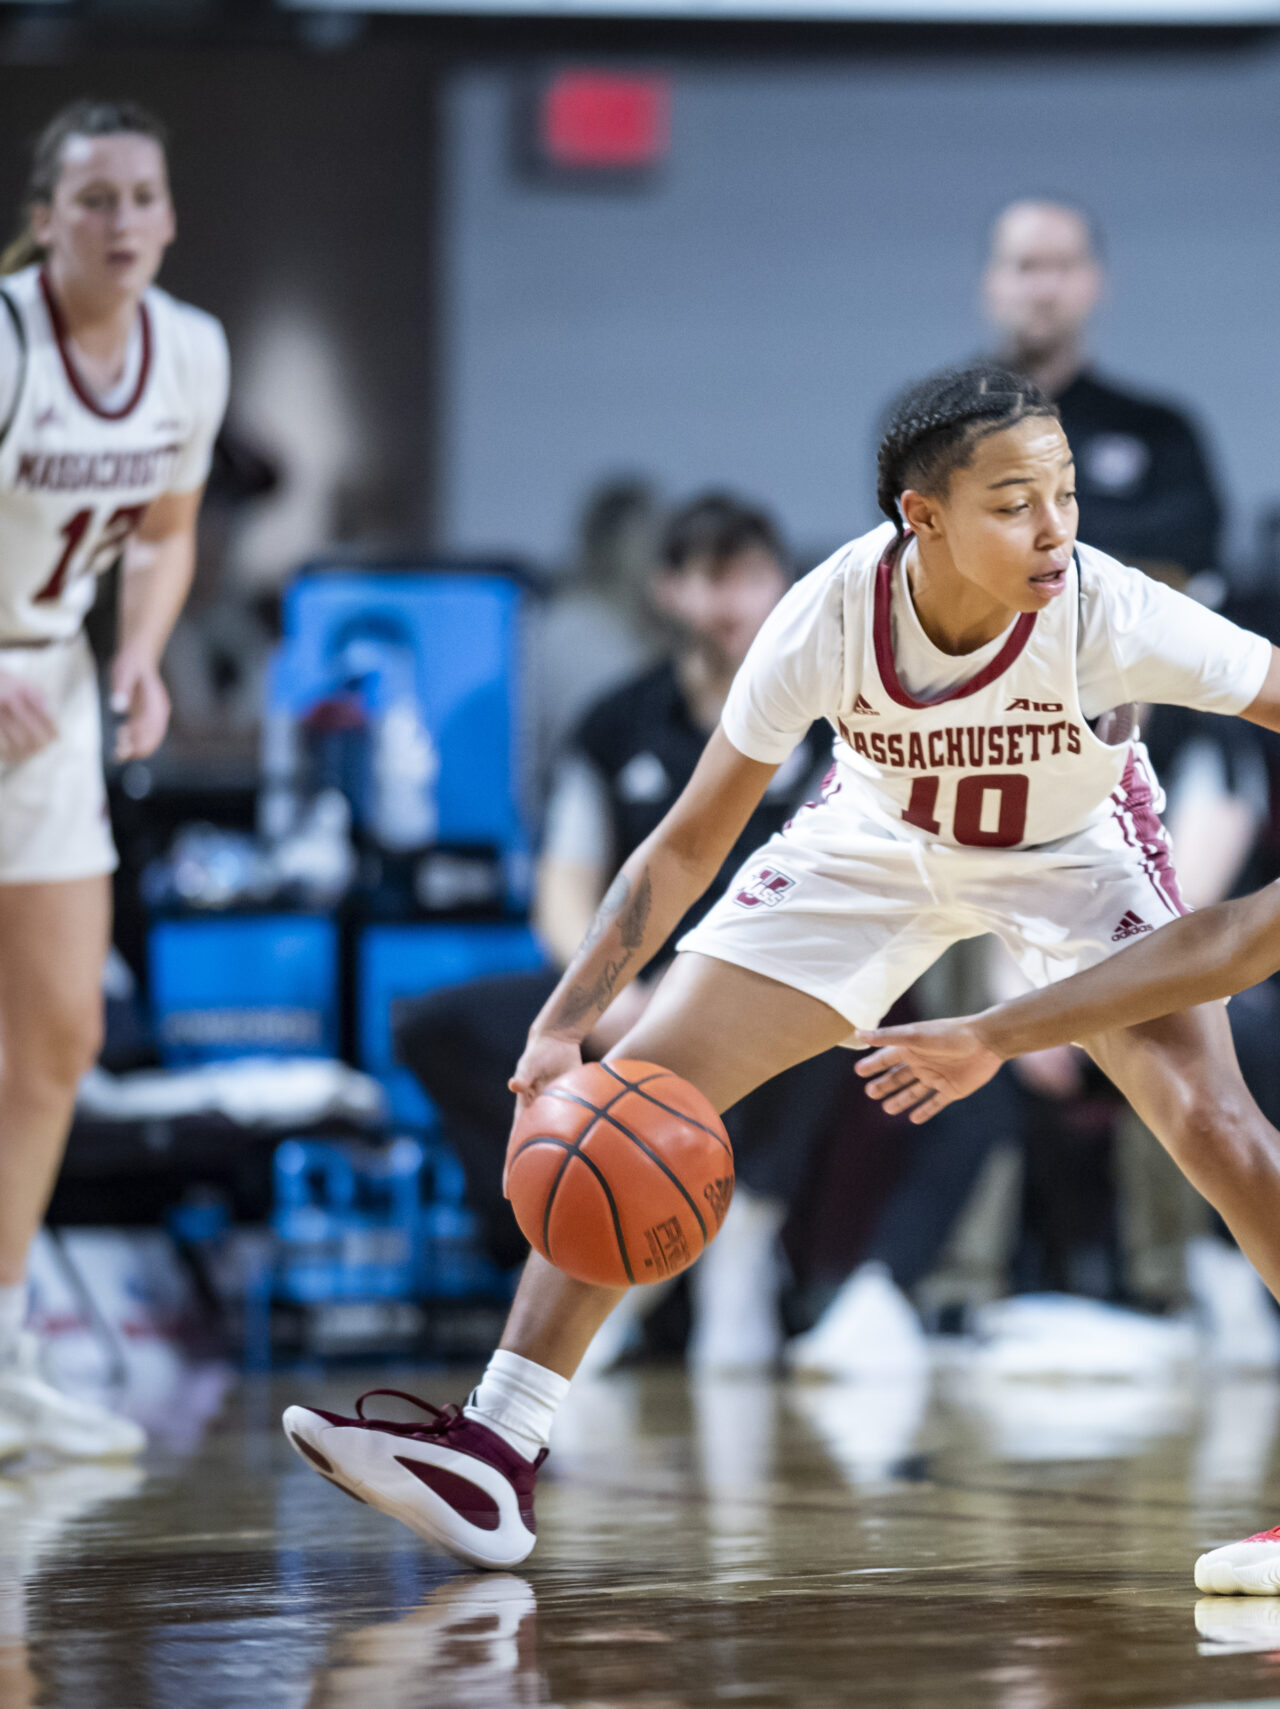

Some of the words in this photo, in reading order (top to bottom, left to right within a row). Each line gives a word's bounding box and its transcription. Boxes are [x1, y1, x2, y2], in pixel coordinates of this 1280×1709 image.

[1004, 698, 1063, 713] A10
[901, 773, 1029, 848] 10
[1111, 924, 1154, 942] adidas
